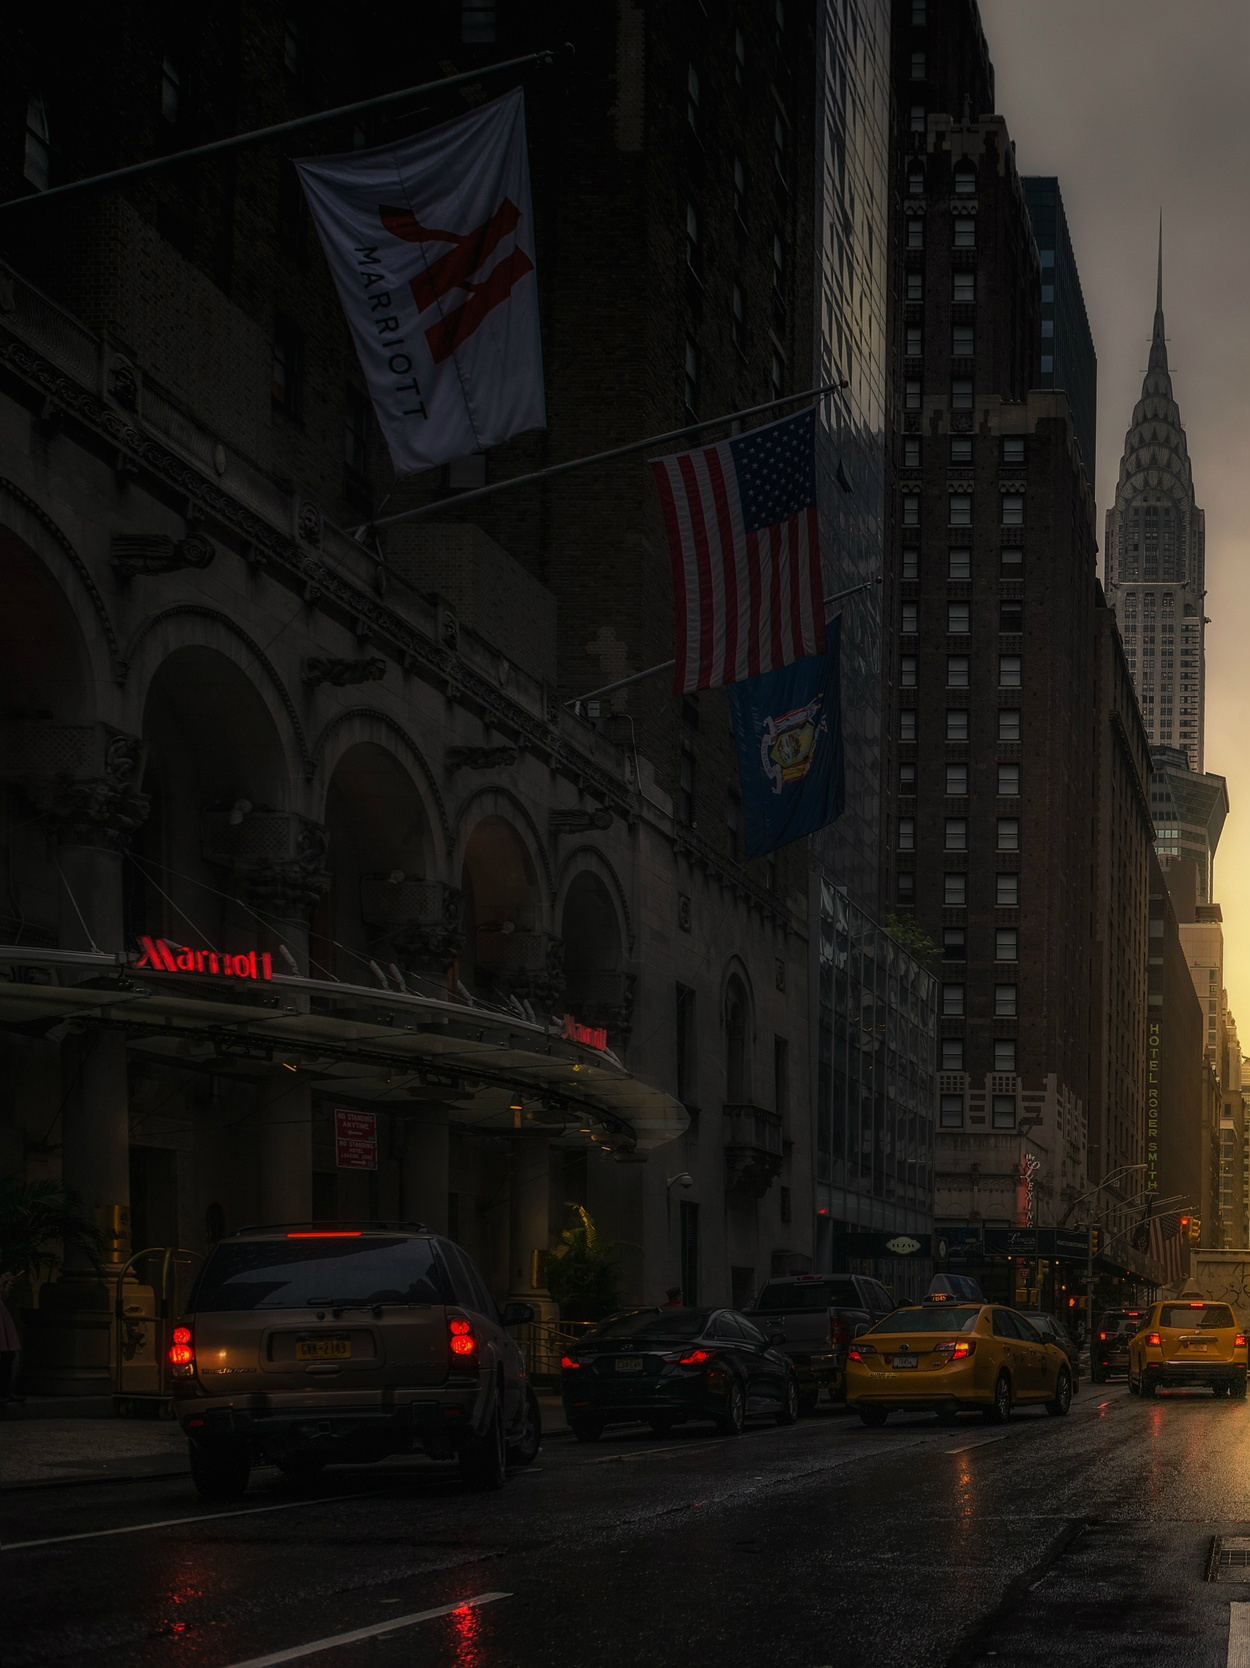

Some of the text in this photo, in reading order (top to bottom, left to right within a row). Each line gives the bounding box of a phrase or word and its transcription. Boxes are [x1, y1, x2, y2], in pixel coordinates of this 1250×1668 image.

[354, 246, 428, 420] MARRIOTT
[132, 935, 273, 981] Marriott
[342, 1120, 370, 1130] ANYTIME
[347, 1114, 374, 1122] STANDING
[1147, 1024, 1160, 1189] HOTEL ROGER SMITH
